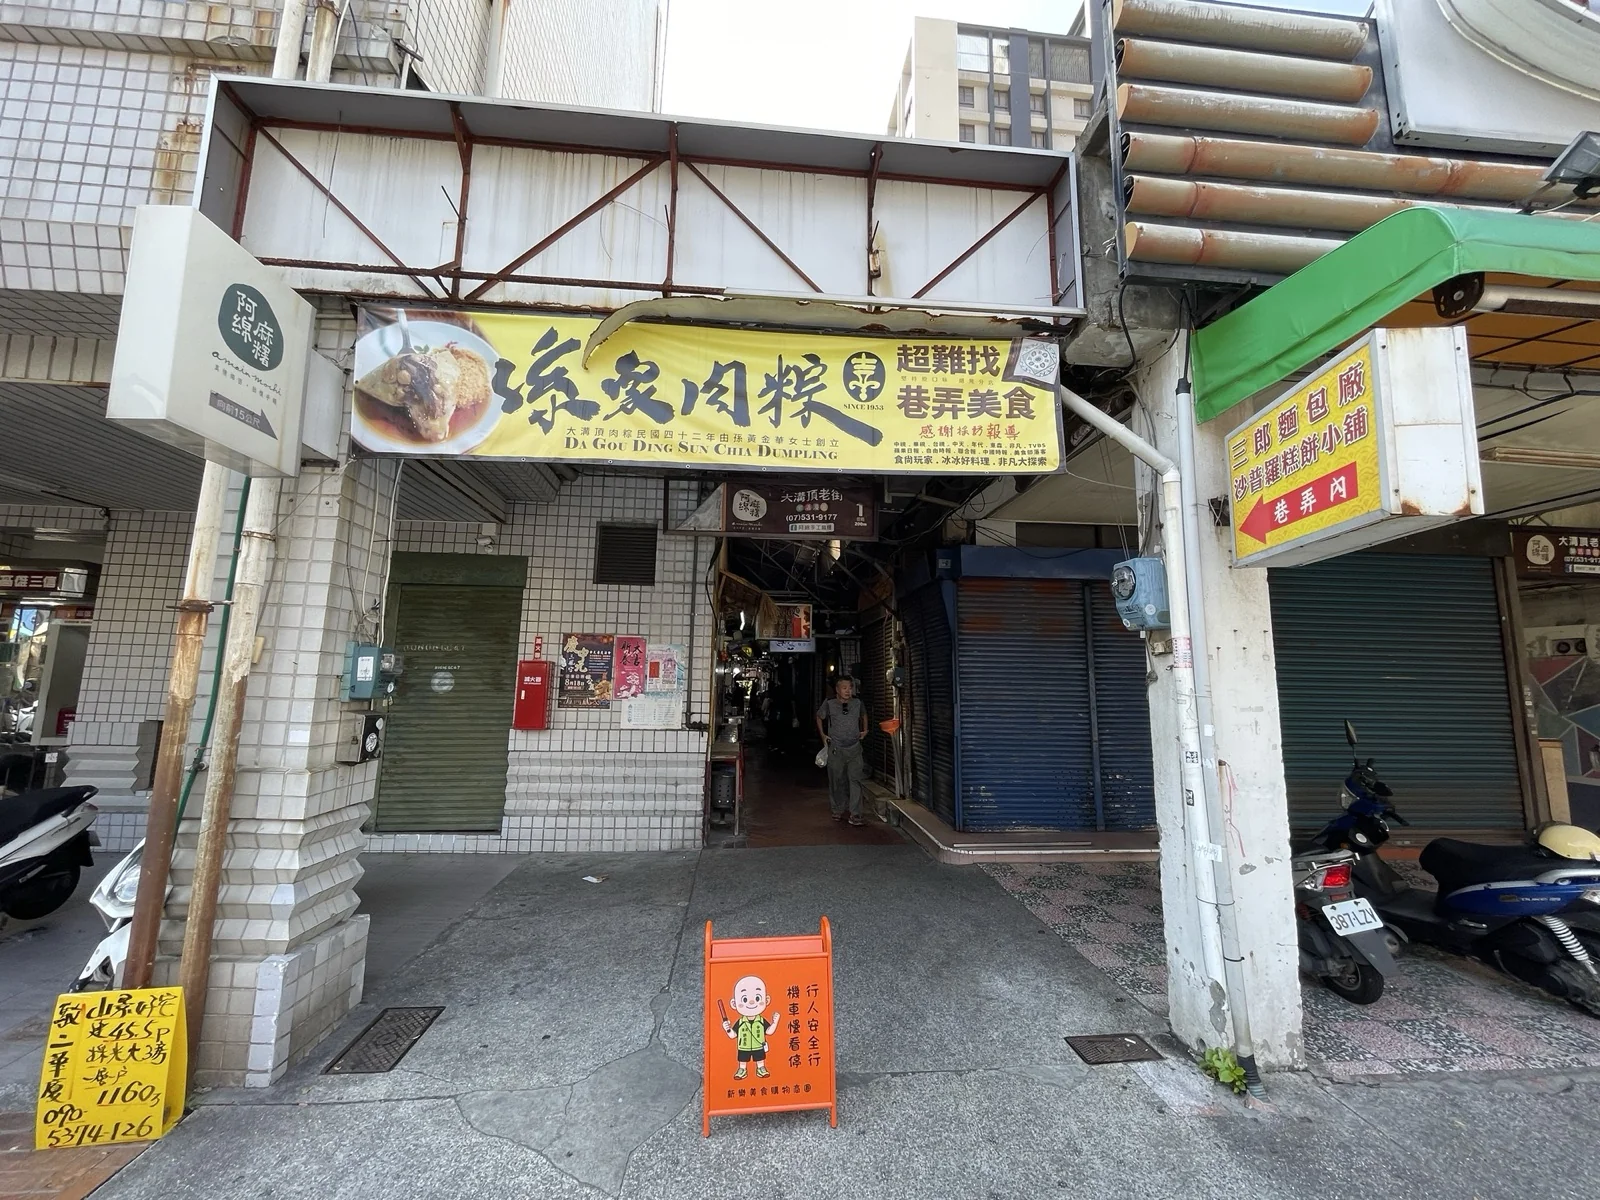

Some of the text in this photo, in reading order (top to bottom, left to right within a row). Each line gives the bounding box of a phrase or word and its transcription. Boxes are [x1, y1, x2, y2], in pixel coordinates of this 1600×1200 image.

[896, 343, 1001, 377] 超難找
[843, 403, 884, 412] SINCE 1953
[896, 384, 1037, 420] 巷弄美食
[1231, 360, 1366, 471] 三郎麵包廠
[564, 436, 839, 461] DA GOU DING SUN CHIA DUMPLING
[918, 422, 1021, 441] 感謝採訪報導
[1233, 405, 1369, 503] 沙普羅糕餅小舖
[781, 488, 843, 503] 大溝頂老街
[1274, 475, 1348, 525] 巷弄內
[785, 513, 838, 522] (07)531-9177
[786, 985, 802, 1068] 機車慢看停
[805, 983, 821, 1067] 行人安全行
